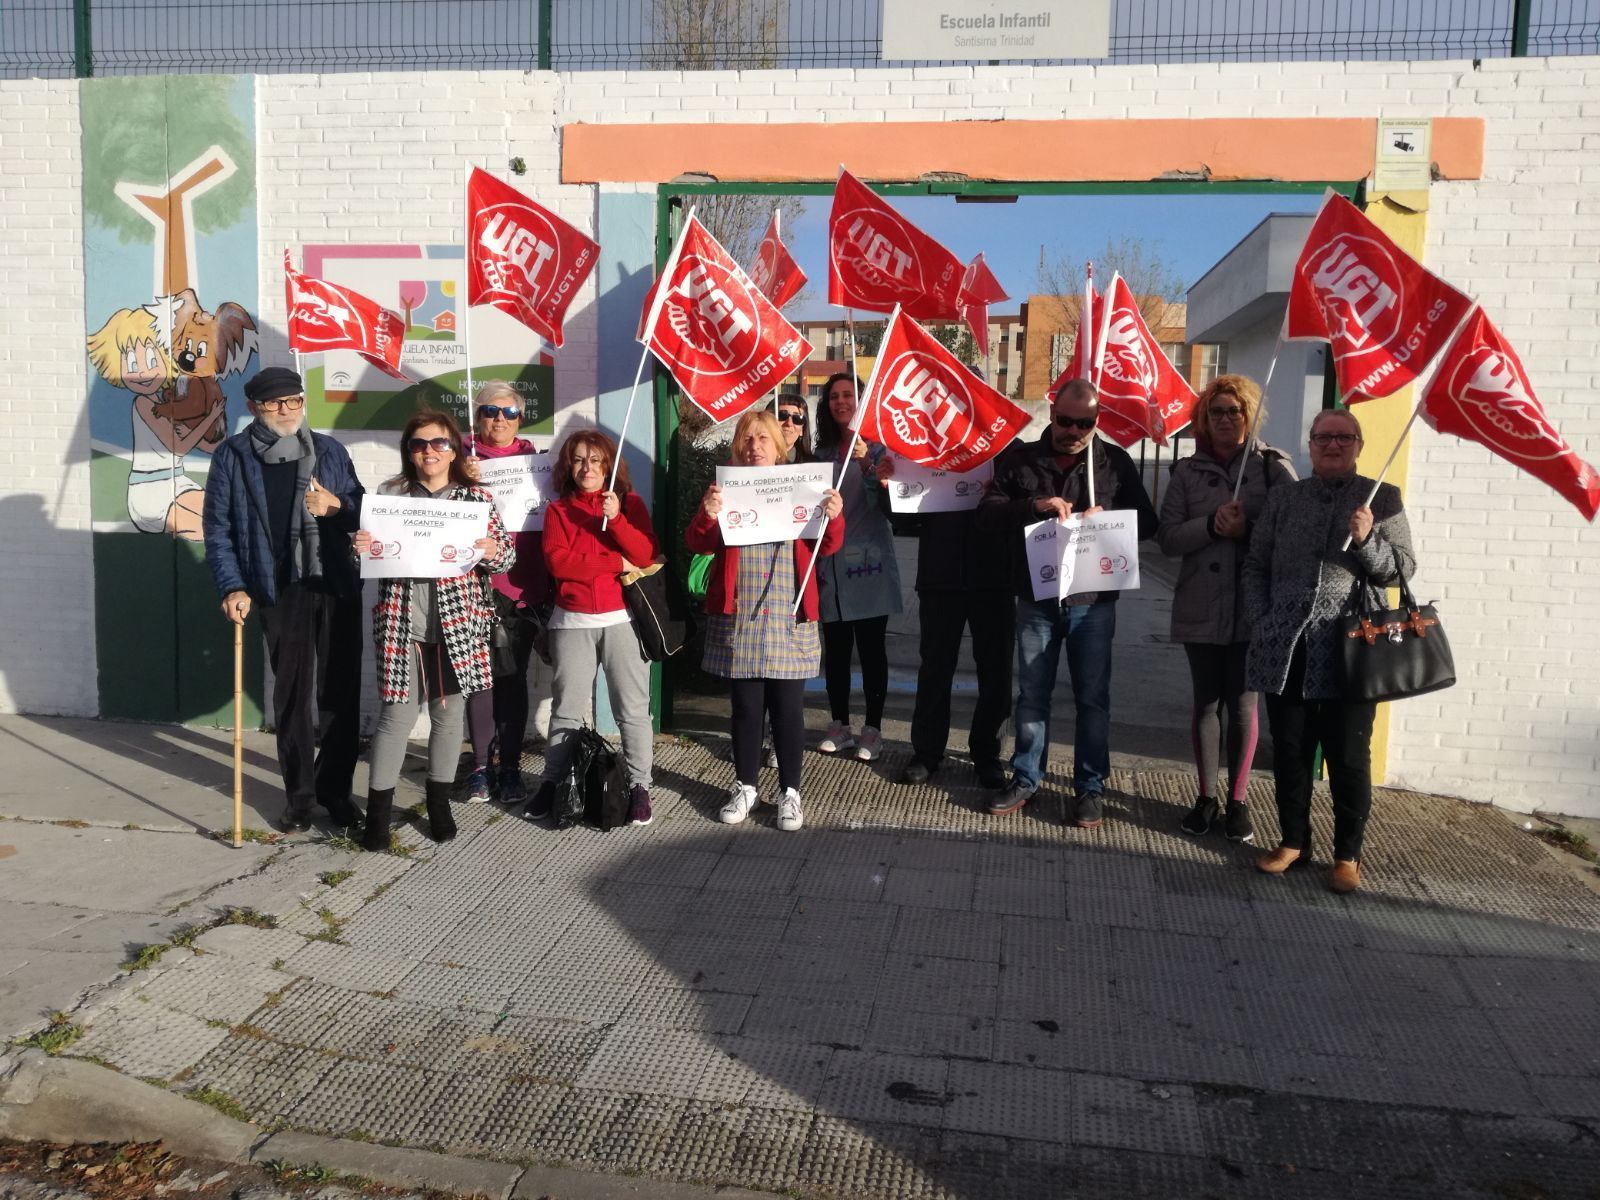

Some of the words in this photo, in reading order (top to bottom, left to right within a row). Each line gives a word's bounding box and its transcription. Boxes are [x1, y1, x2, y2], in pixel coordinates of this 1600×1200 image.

[940, 14, 995, 29] Escuela
[999, 12, 1051, 28] Infantil
[1000, 34, 1035, 47] Trinidad
[480, 212, 554, 285] UGT
[848, 217, 913, 280] UGT
[1313, 242, 1397, 332] UGT
[681, 263, 753, 342] UGT
[710, 338, 799, 411] www.UGT.es
[894, 358, 967, 435] UGT
[939, 415, 1007, 472] www.ugt.es
[485, 468, 524, 477] COBERTURA
[753, 476, 795, 486] COBERTURA
[755, 486, 794, 495] VACANTES
[402, 509, 448, 517] COBERTURA
[403, 519, 445, 527] VACANTES
[1035, 534, 1046, 542] POR
[1070, 534, 1097, 543] CANTES
